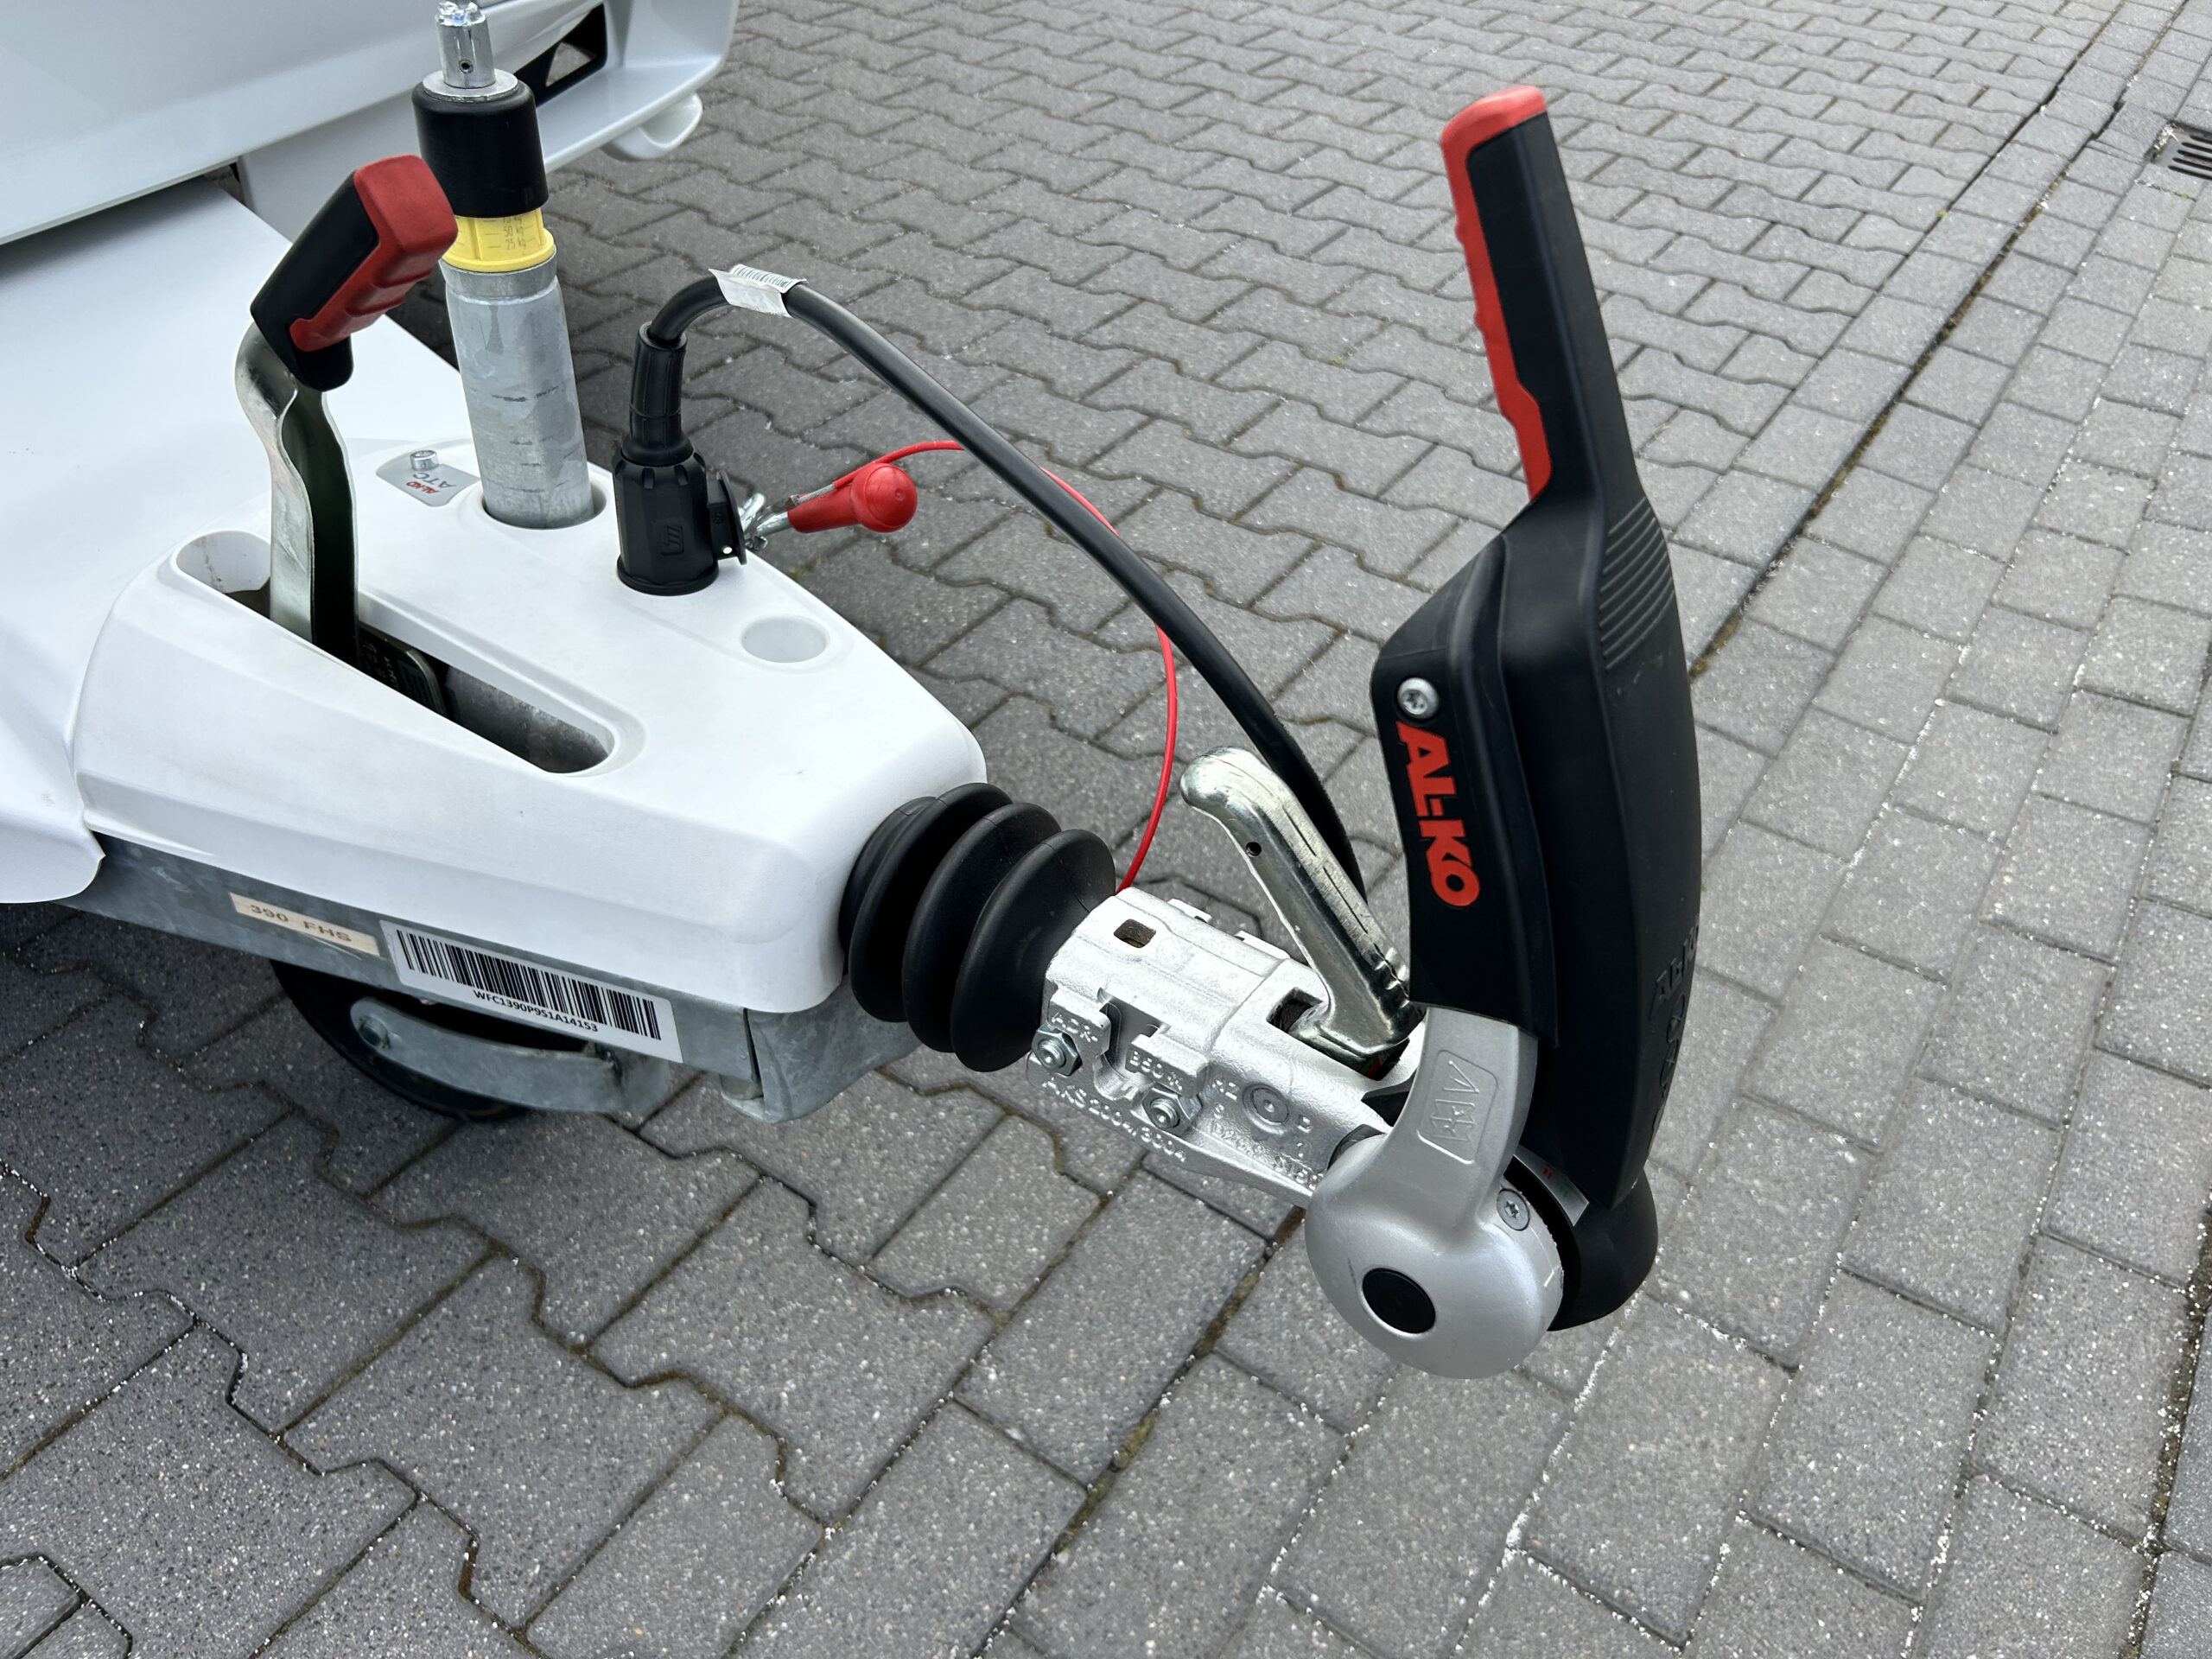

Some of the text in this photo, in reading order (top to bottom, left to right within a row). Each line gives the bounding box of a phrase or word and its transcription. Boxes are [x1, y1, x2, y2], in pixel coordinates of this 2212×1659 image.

[504, 225, 513, 238] 50
[412, 472, 457, 488] ATC
[1395, 721, 1480, 906] AL-KO
[250, 905, 353, 943] 390 FHS
